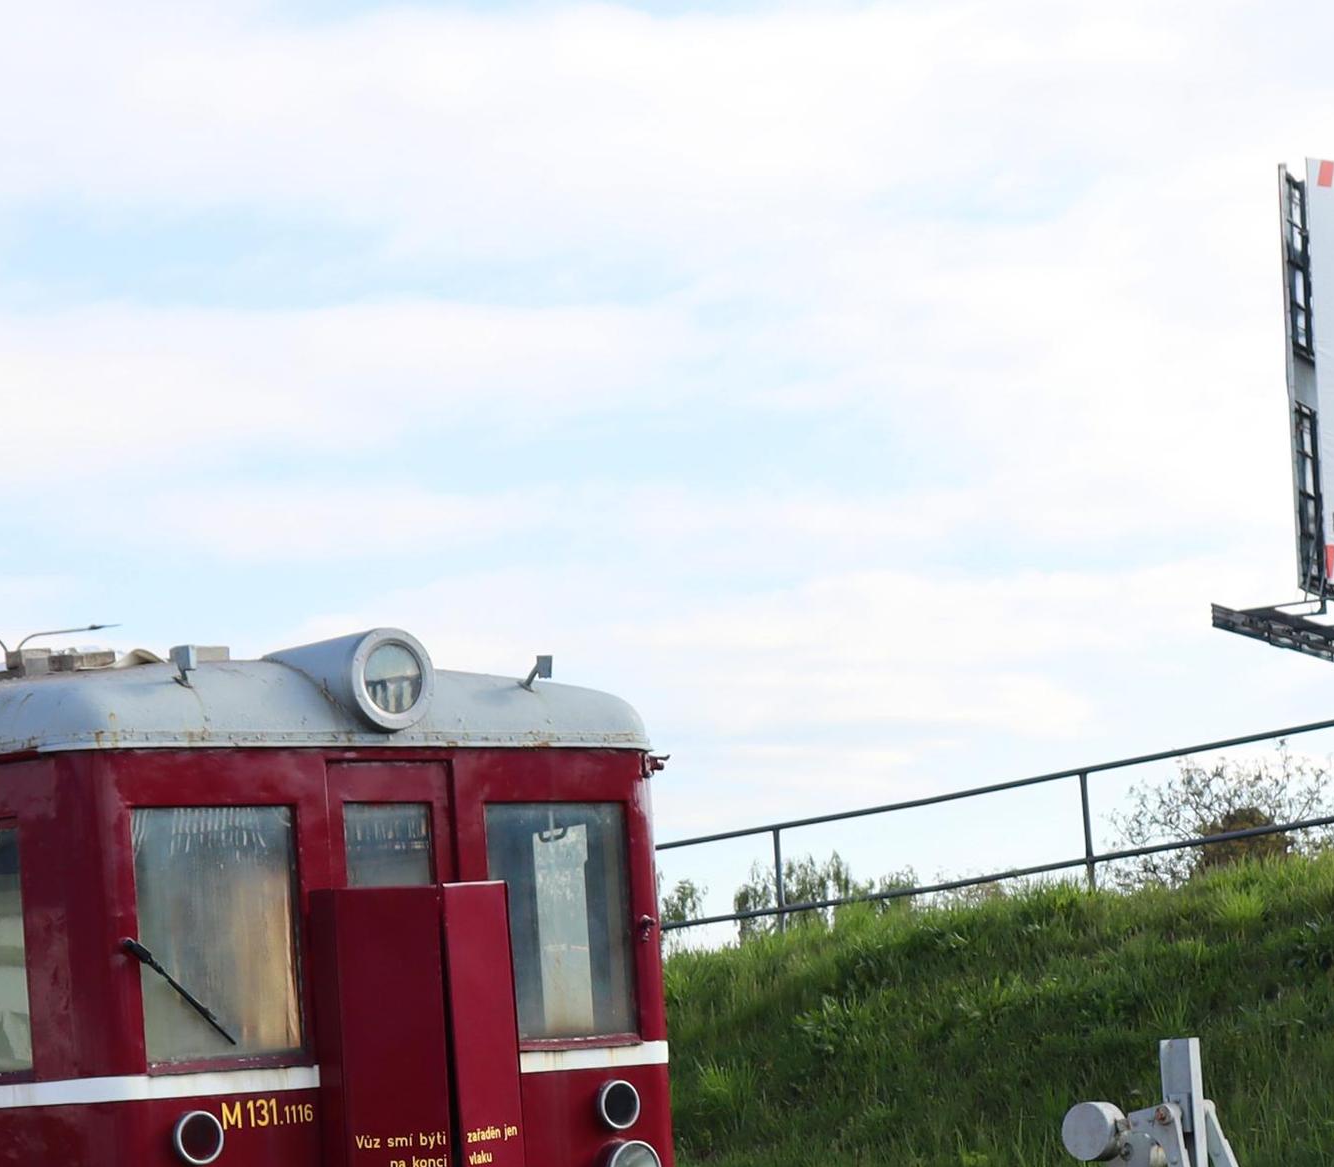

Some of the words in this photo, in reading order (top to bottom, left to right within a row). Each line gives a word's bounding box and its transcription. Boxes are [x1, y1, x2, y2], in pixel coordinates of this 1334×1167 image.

[387, 1133, 413, 1148] smí
[419, 1131, 447, 1150] býti
[467, 1126, 501, 1143] zařaděn
[504, 1123, 518, 1141] jen
[469, 1150, 493, 1166] vlaku
